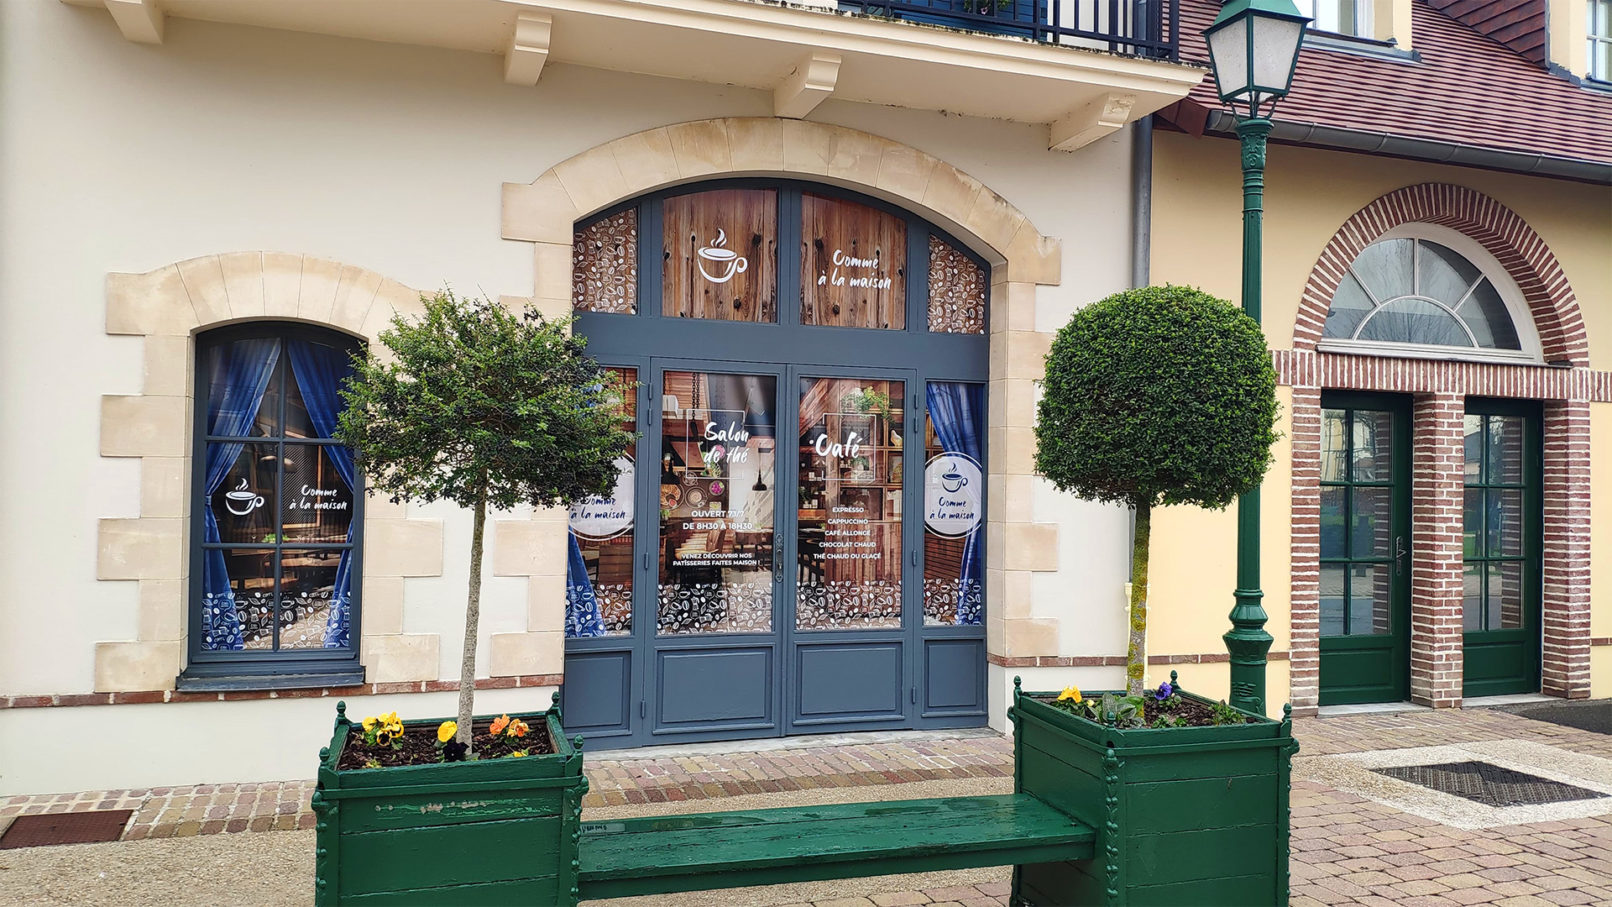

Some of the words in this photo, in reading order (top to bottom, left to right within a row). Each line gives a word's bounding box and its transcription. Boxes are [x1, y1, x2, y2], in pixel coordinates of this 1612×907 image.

[833, 249, 878, 268] Comme
[818, 270, 826, 285] à
[831, 268, 845, 286] la
[850, 272, 891, 289] maison
[704, 421, 749, 442] Salon
[816, 431, 863, 459] Café
[703, 446, 720, 463] de
[726, 446, 748, 463] thé
[301, 484, 337, 496] Comme
[289, 499, 296, 509] à
[300, 497, 311, 509] la
[314, 499, 347, 510] maison
[939, 497, 966, 507] Comme
[581, 506, 591, 519] la
[595, 508, 625, 519] maison
[938, 508, 946, 519] la
[949, 510, 974, 519] maison
[682, 522, 695, 530] DE
[696, 522, 718, 530] 8H30
[728, 522, 753, 530] 18H30
[813, 552, 826, 560] THÉ
